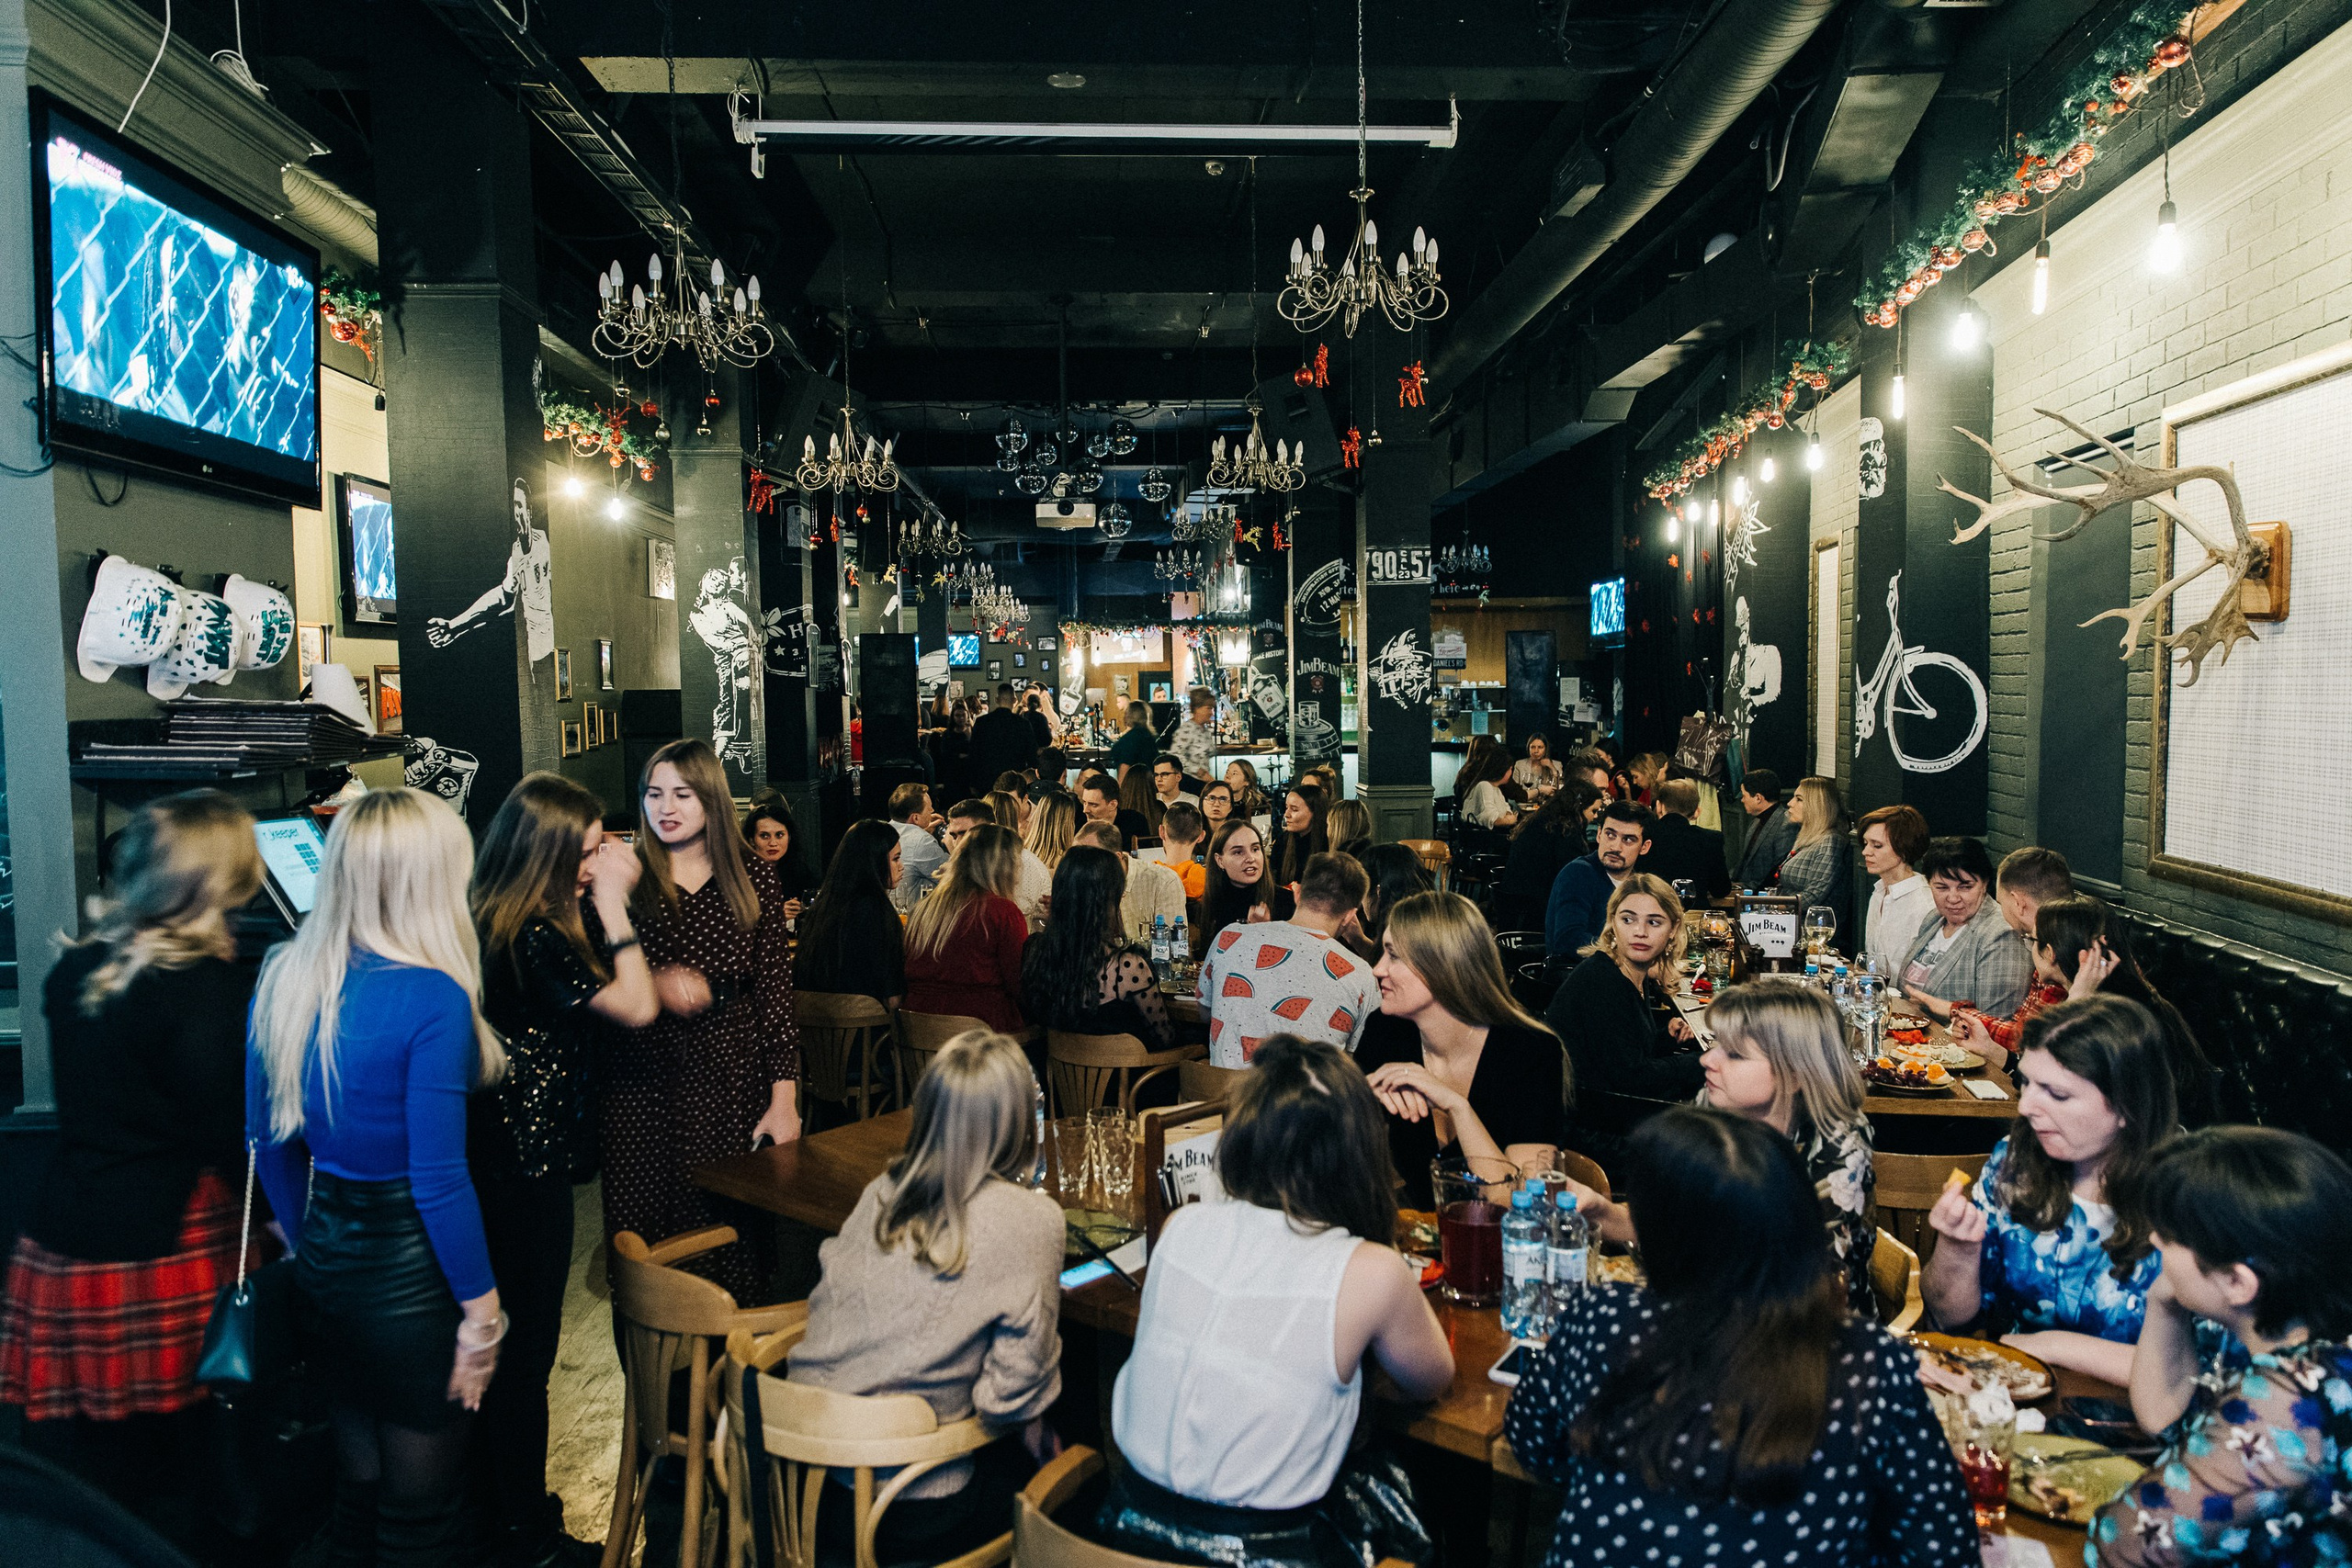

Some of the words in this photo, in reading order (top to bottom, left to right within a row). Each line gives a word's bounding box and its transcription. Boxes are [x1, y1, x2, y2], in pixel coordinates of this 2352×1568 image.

[285, 265, 305, 289] 18+
[1397, 570, 1411, 580] 23
[1746, 921, 1761, 936] JIM
[1763, 919, 1787, 934] BEAM
[1185, 1148, 1215, 1171] BEAM
